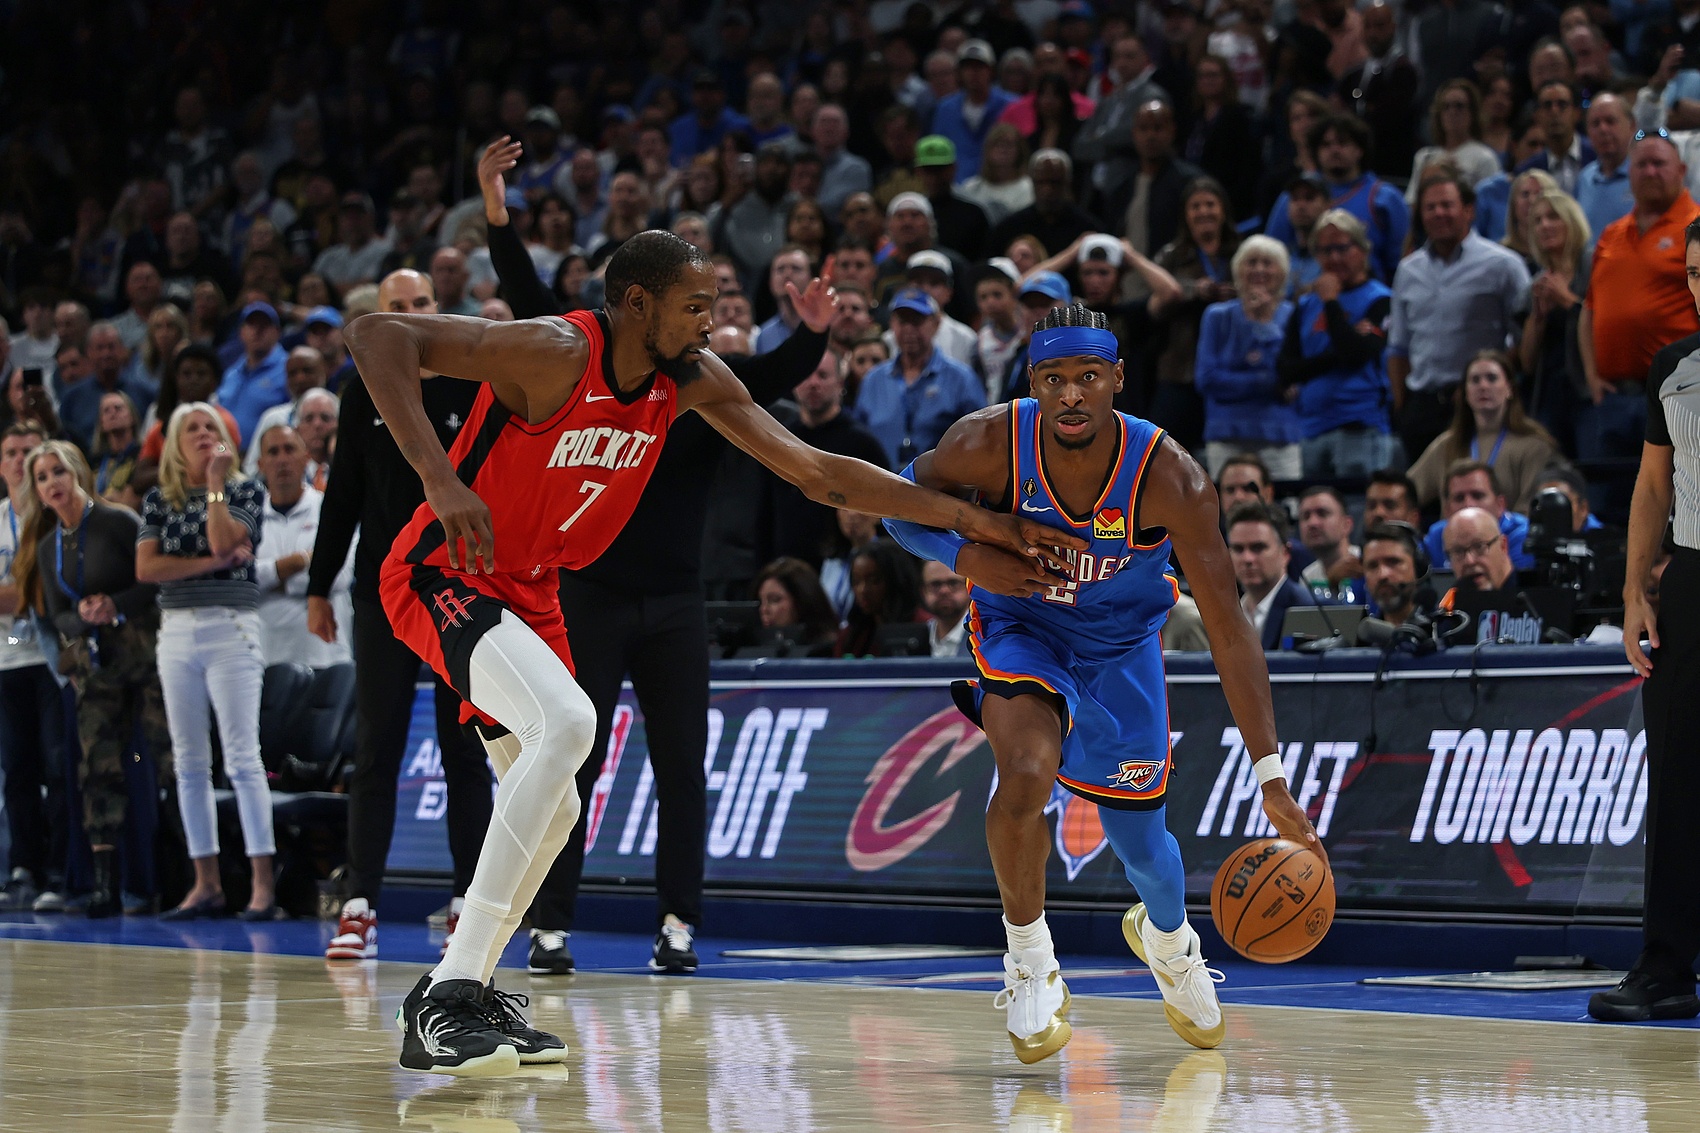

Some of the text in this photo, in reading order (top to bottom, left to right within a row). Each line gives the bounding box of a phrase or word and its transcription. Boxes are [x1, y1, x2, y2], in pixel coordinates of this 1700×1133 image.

[545, 427, 657, 471] ROCKTS
[558, 480, 607, 532] 7
[1499, 611, 1543, 644] Replay
[1119, 766, 1152, 782] OKC
[1409, 728, 1649, 846] TOMORRO
[1226, 841, 1286, 900] Wilso
